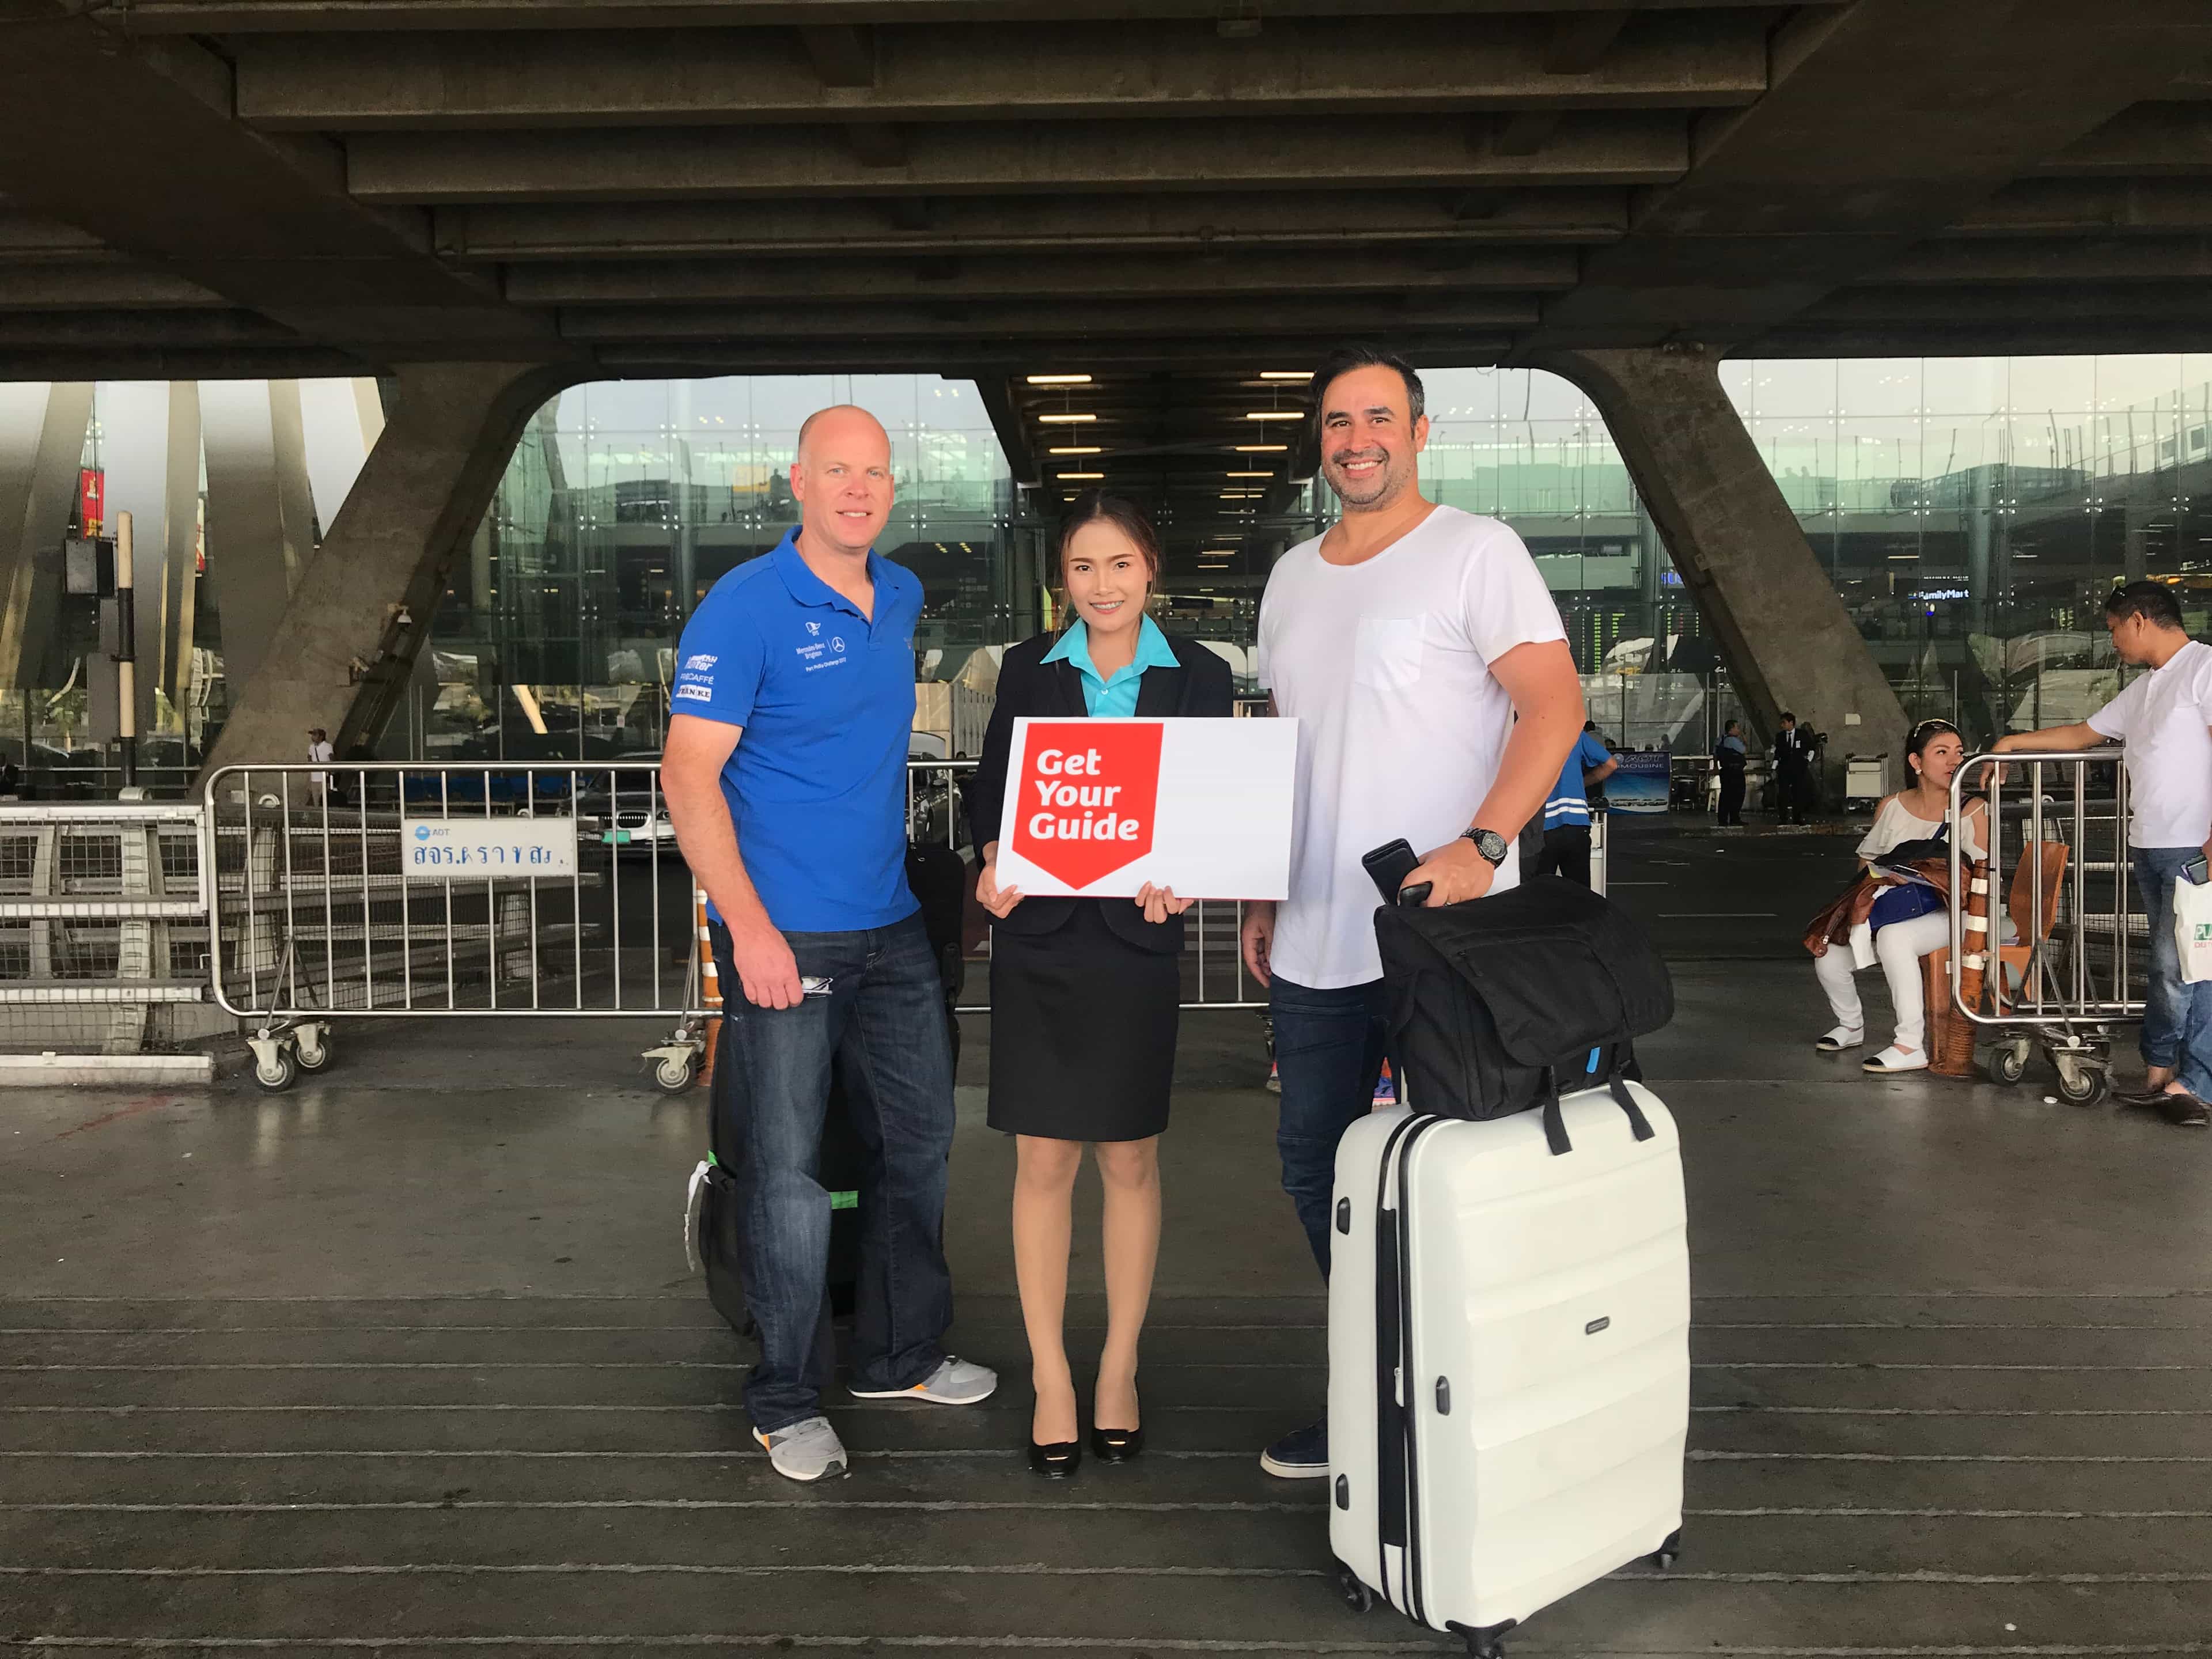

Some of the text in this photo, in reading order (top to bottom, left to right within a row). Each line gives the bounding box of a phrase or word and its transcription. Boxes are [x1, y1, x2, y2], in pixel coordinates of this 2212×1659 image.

[1919, 589, 1969, 600] FamilyMart
[1036, 748, 1101, 775] Get
[1035, 780, 1122, 806] Your
[1029, 811, 1139, 840] Guide
